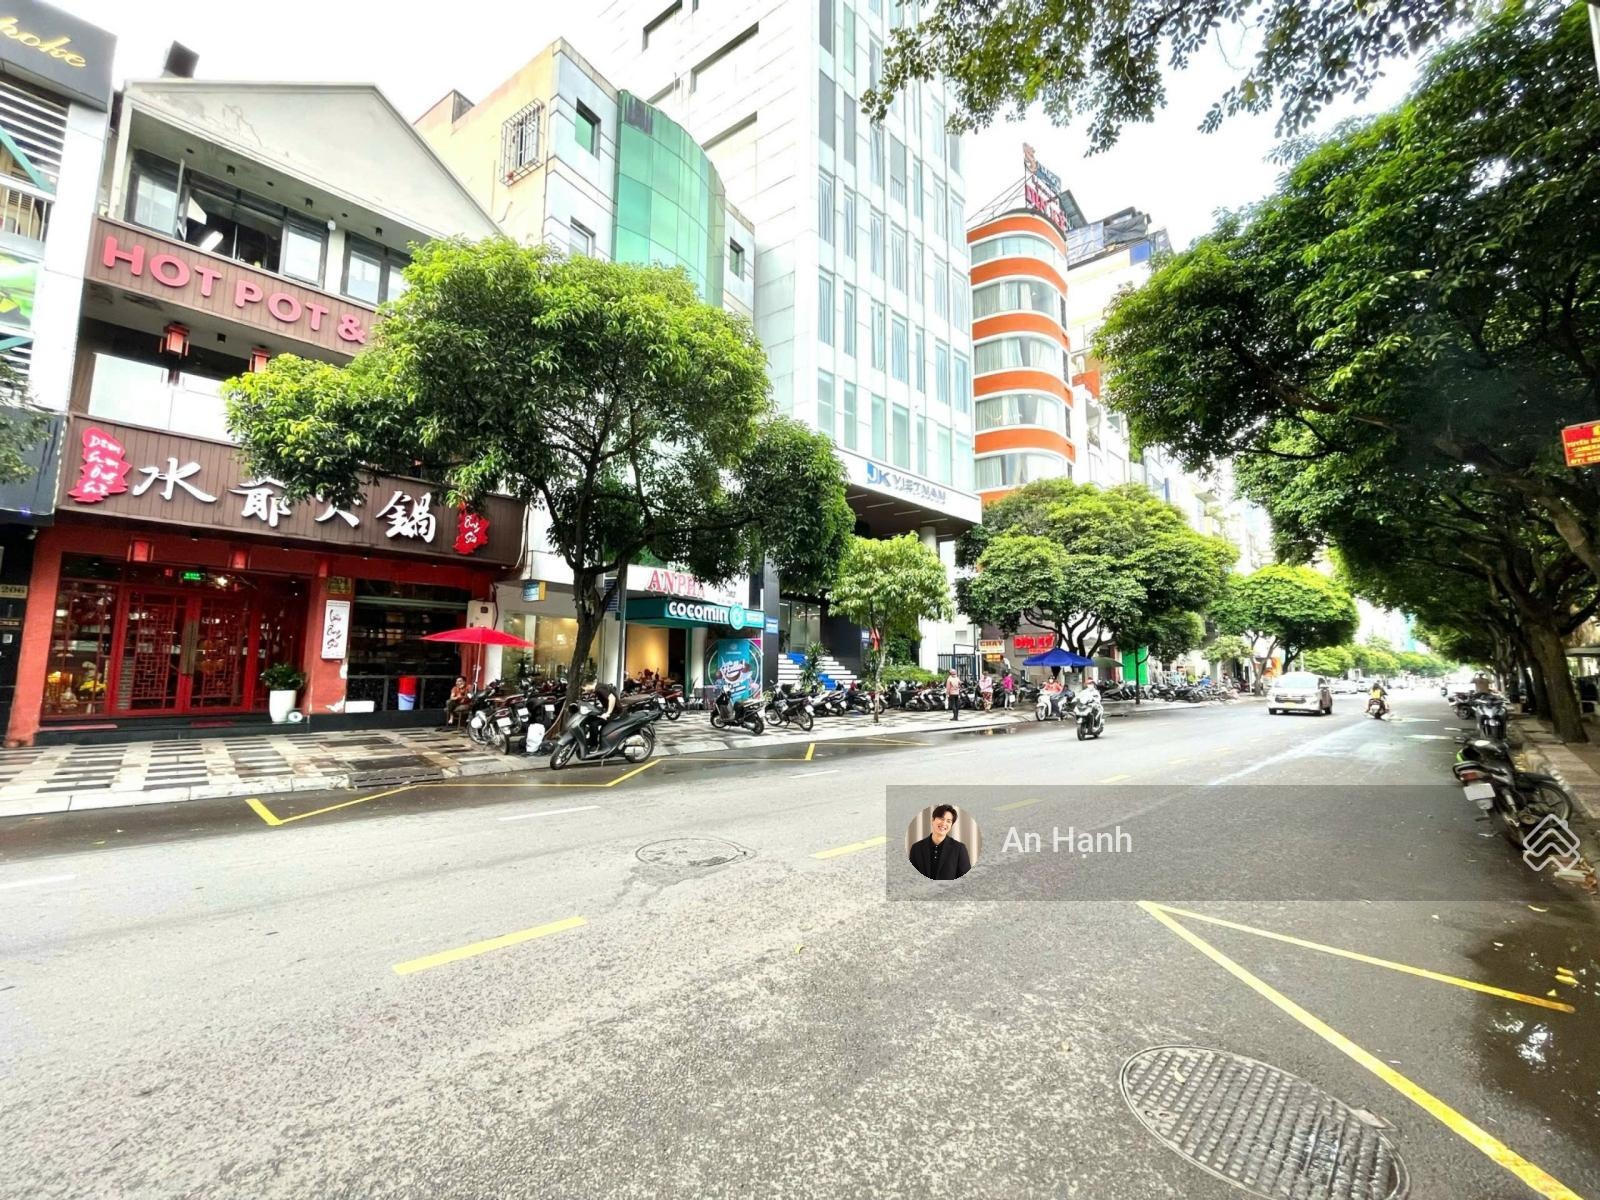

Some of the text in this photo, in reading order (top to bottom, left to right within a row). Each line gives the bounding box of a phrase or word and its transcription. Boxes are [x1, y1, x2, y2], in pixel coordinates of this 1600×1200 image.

[103, 235, 366, 345] HOT POT &
[668, 601, 727, 624] cocomin
